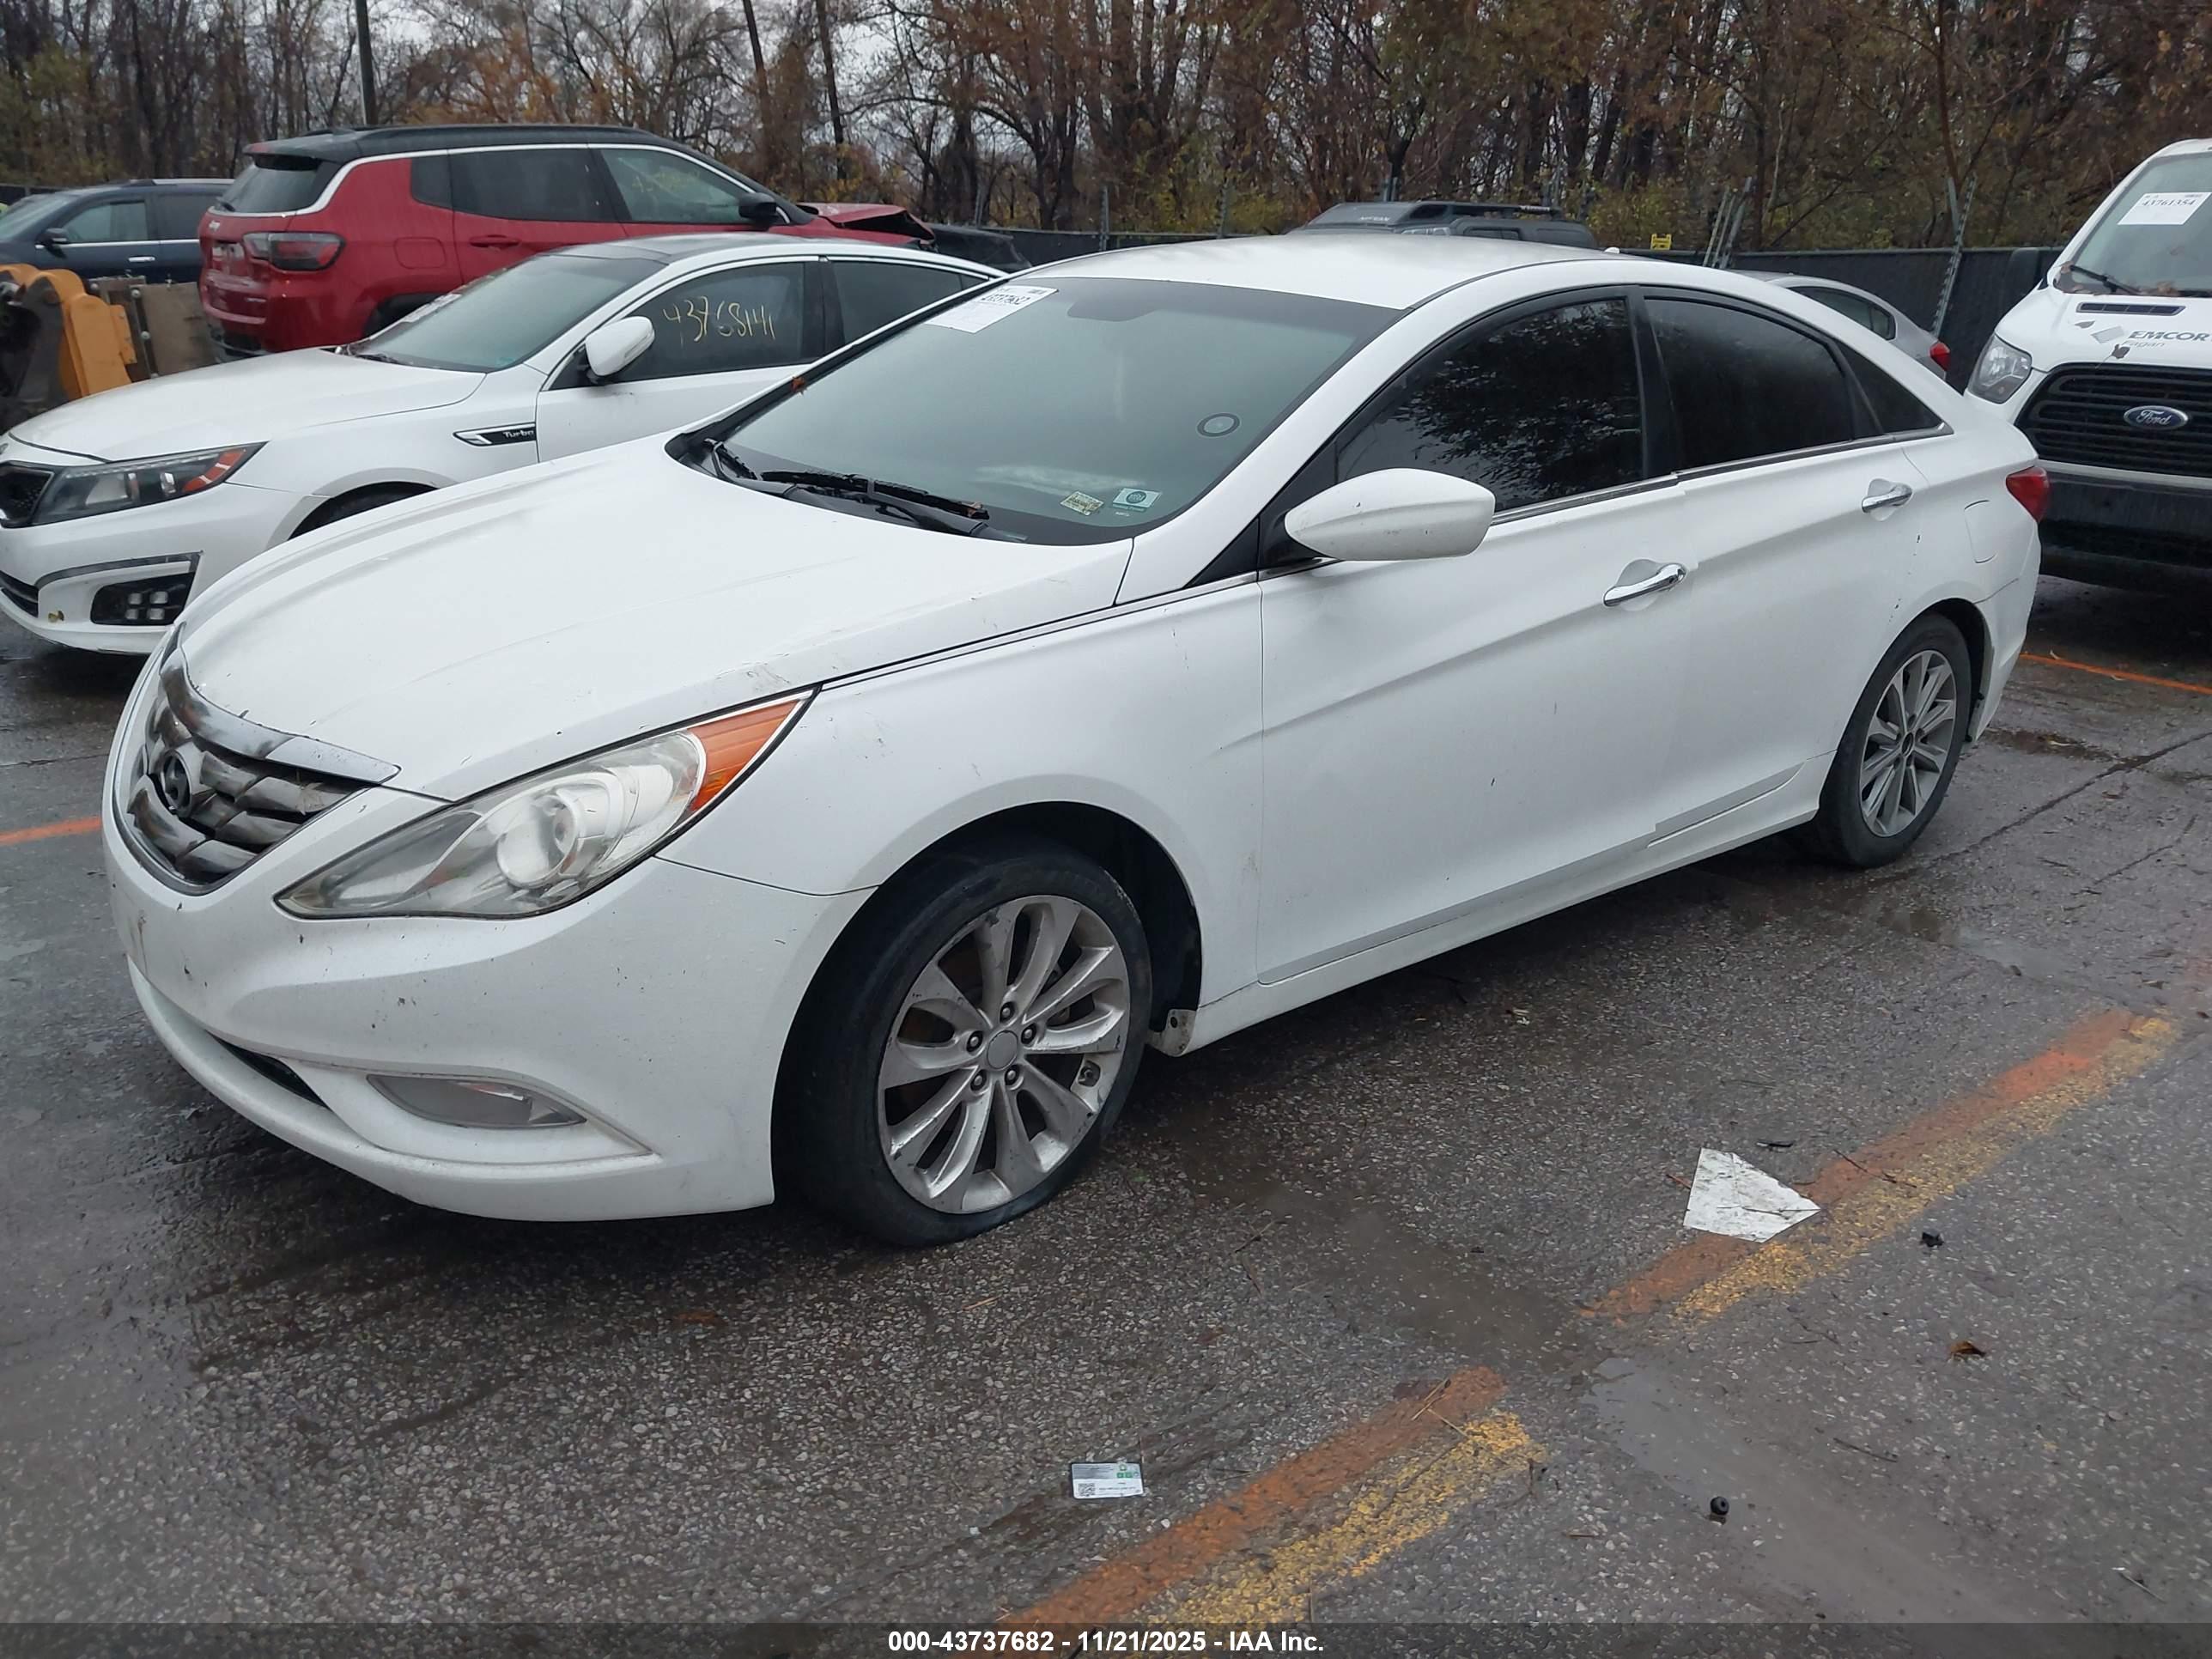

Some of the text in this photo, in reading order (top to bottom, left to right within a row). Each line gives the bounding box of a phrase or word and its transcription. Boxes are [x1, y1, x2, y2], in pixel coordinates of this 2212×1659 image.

[2128, 331, 2209, 342] EMCOR
[2136, 409, 2172, 426] Ford
[502, 429, 534, 439] Turbo
